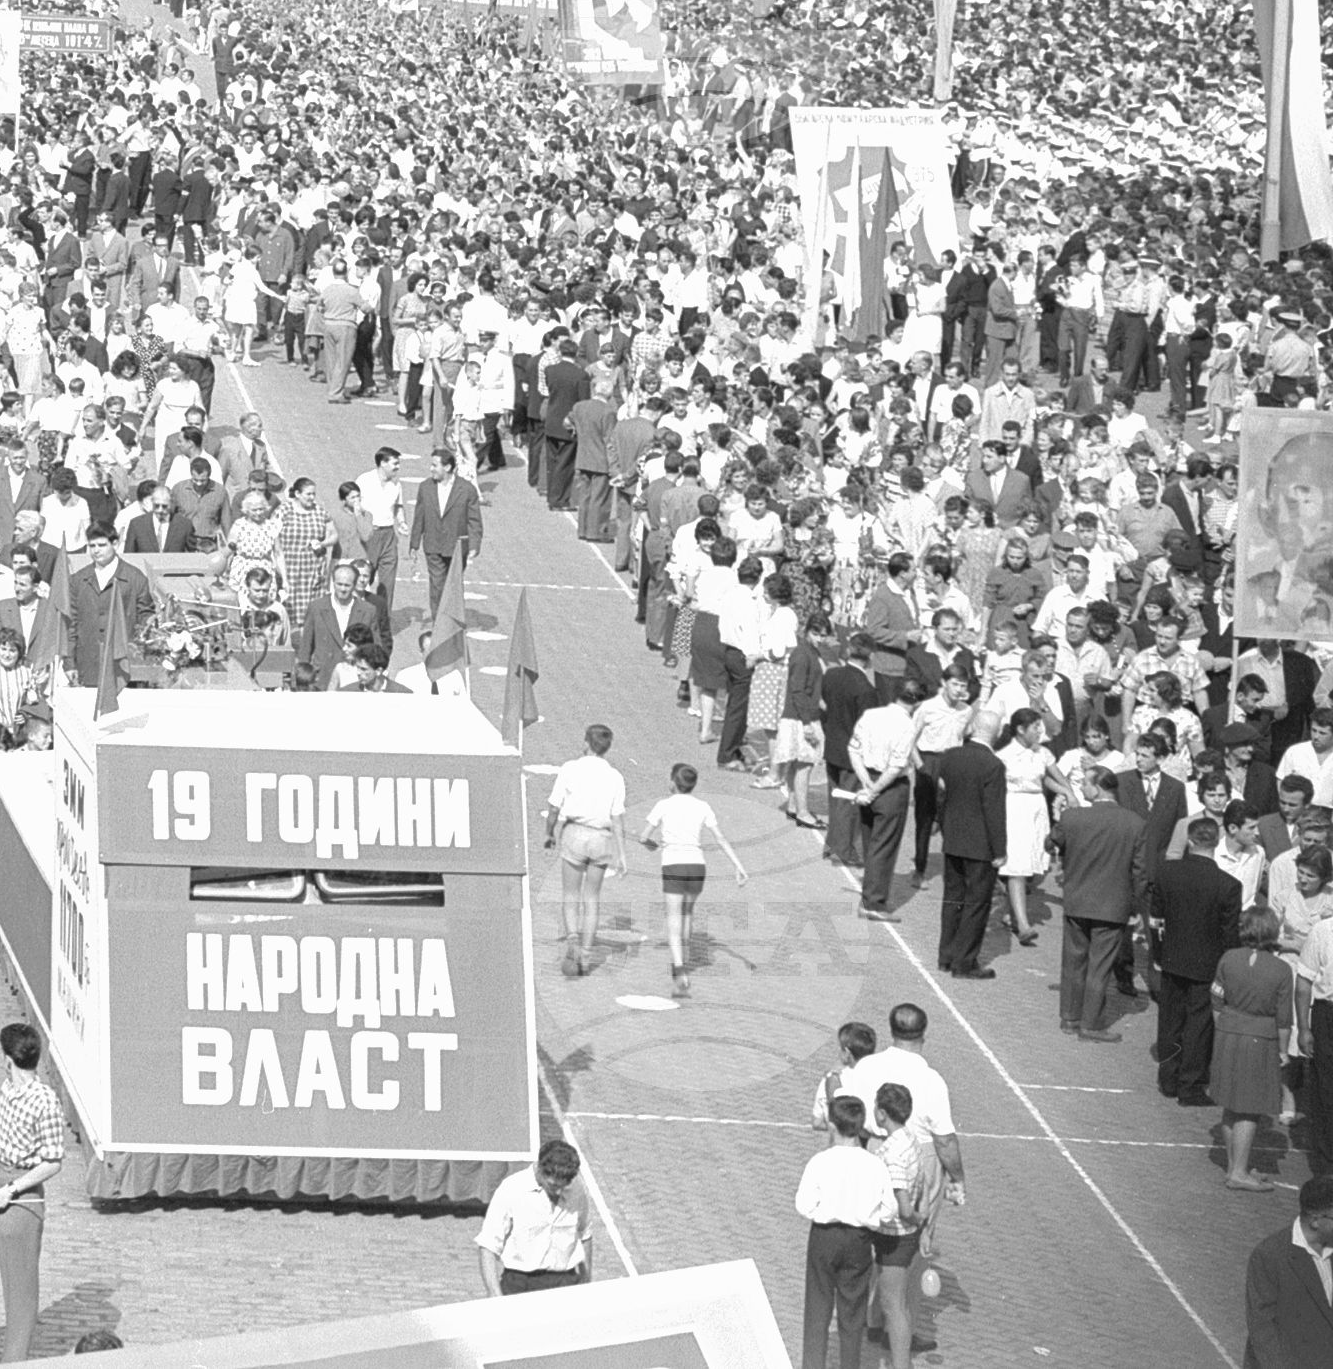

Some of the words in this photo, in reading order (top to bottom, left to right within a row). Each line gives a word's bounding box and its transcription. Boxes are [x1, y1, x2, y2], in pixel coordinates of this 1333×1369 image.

[148, 769, 210, 841] 19
[245, 772, 471, 860] ГОДИНИ
[186, 932, 456, 1029] НАРОДНА
[182, 1026, 458, 1112] ВЛАСТ
